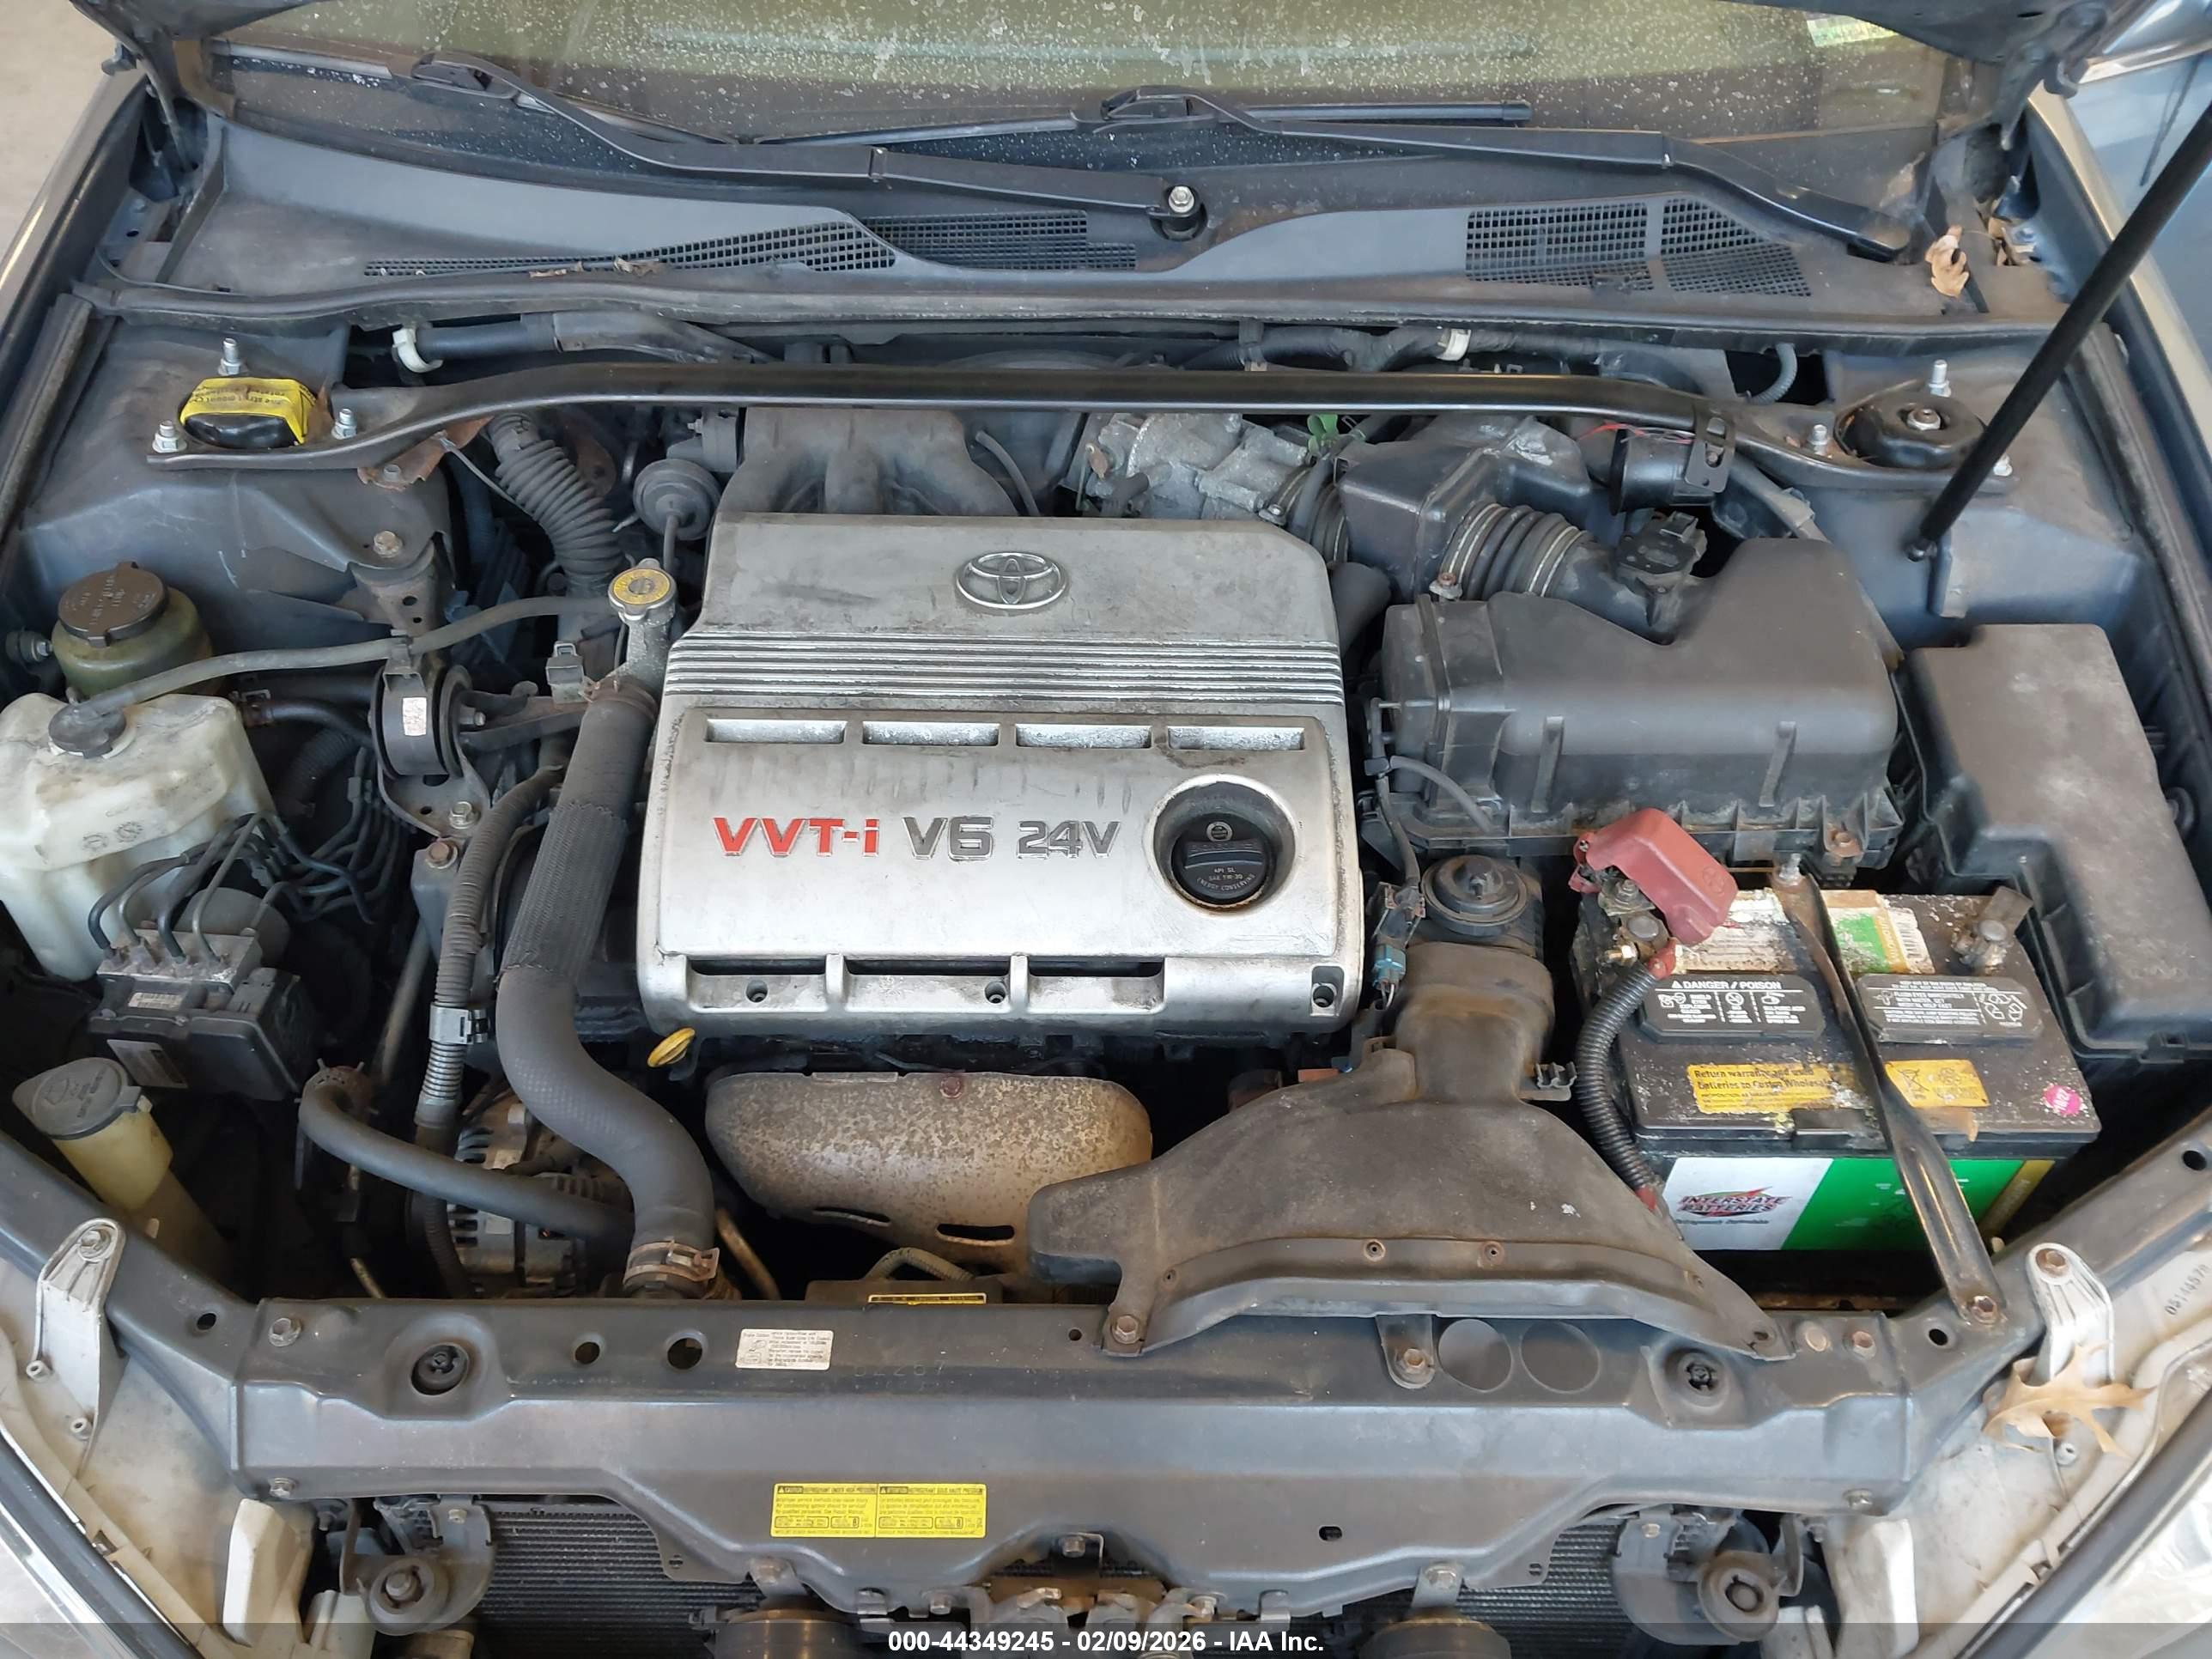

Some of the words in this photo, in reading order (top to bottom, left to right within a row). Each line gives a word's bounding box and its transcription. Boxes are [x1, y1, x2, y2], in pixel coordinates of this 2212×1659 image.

[713, 817, 879, 857] VVT-i
[901, 816, 994, 861] V6
[1017, 820, 1121, 860] 24V
[1682, 981, 1729, 989] DANGER
[1740, 981, 1782, 990] POISON
[1694, 1069, 1726, 1079] Return
[1680, 1195, 1793, 1204] INTERSTATE
[1677, 1203, 1778, 1212] BATTERIES
